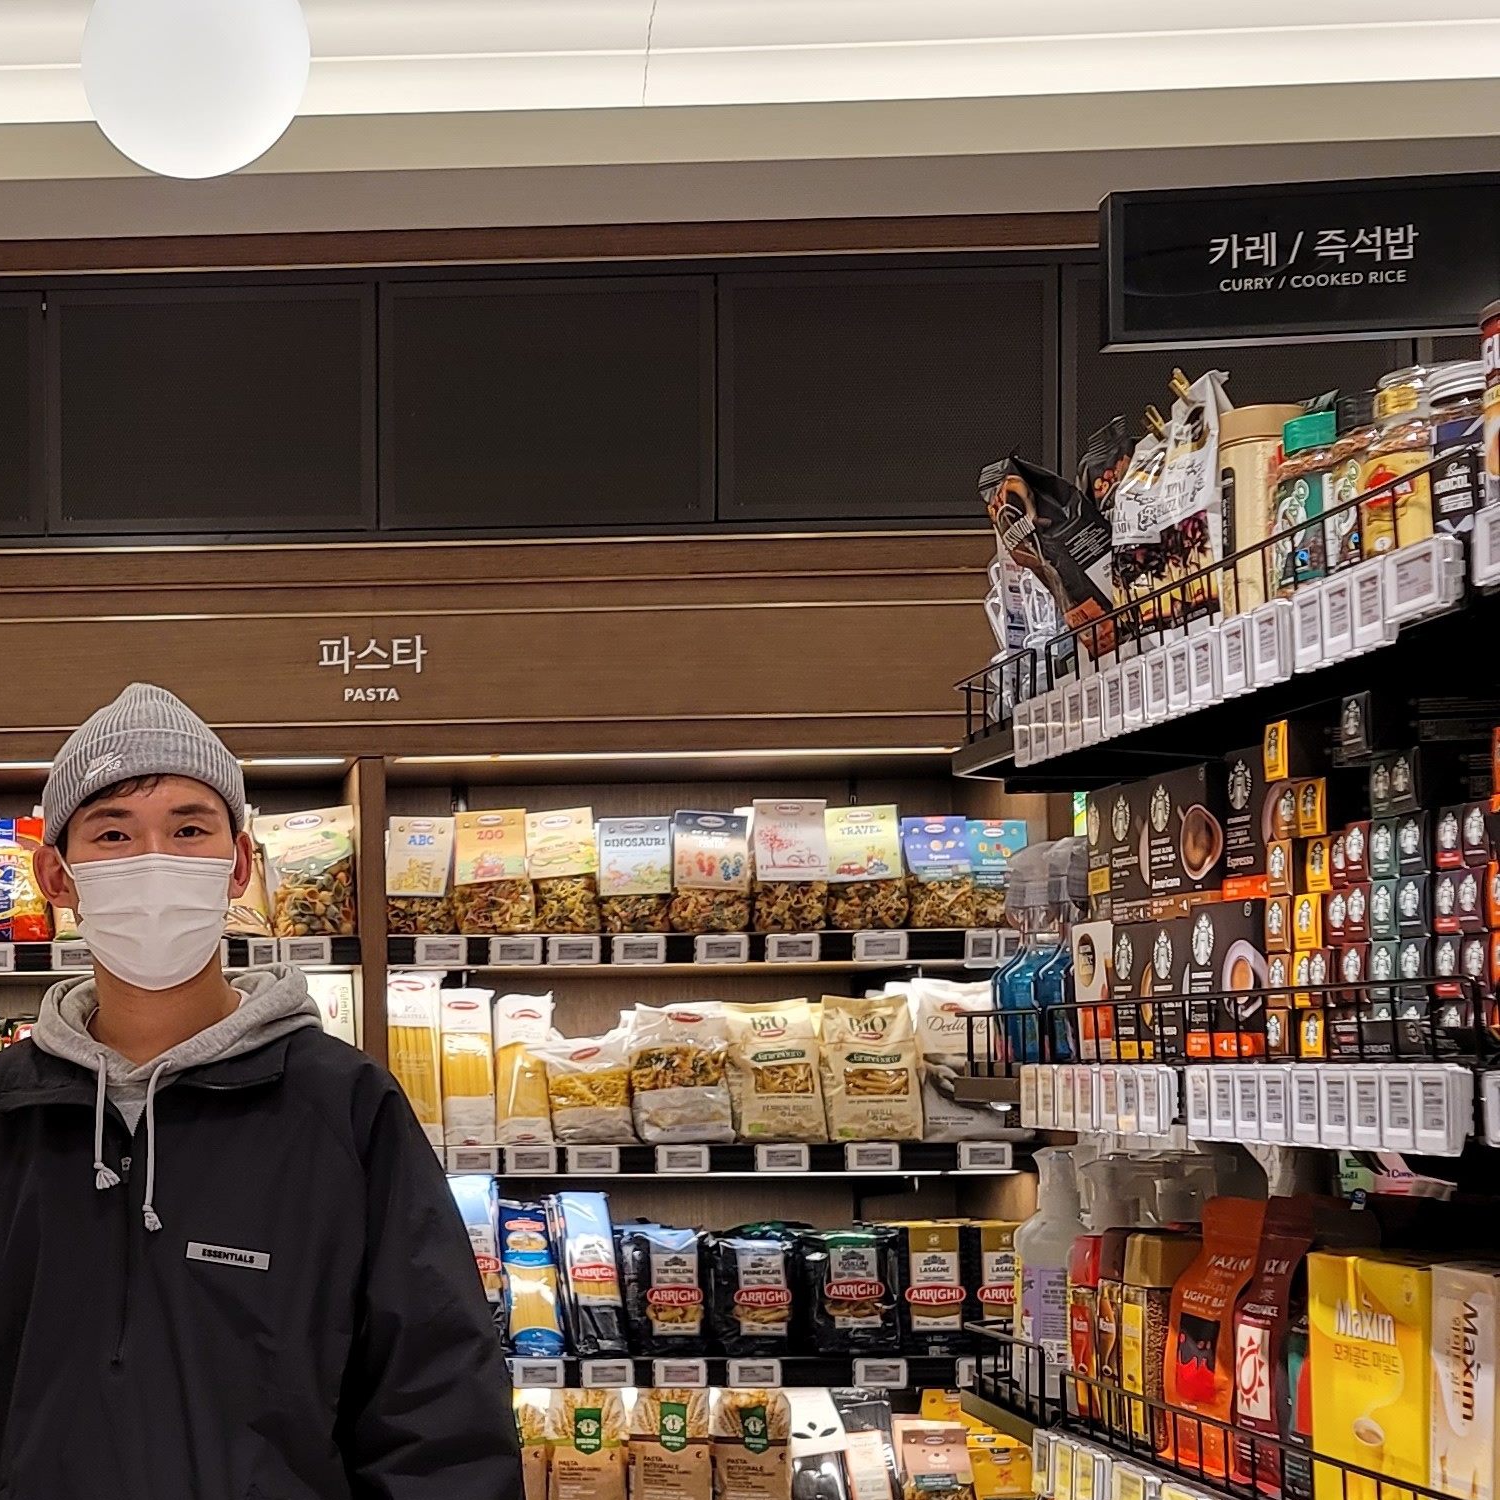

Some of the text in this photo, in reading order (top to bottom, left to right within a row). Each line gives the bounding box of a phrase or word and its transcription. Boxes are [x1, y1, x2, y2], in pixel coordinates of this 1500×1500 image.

[1209, 231, 1277, 269] 카레
[1314, 224, 1419, 264] 즉석밥
[1219, 277, 1274, 292] CURRY
[1290, 272, 1364, 288] COOKED
[1368, 269, 1408, 284] RICE
[319, 635, 428, 674] 파스타
[344, 688, 400, 701] PASTA
[476, 829, 504, 841] ZOO
[839, 825, 882, 836] TRAVEL
[408, 835, 435, 846] ABC
[604, 836, 666, 848] DINOSAURI
[202, 1248, 255, 1264] ESSENTIALS
[919, 1266, 950, 1274] LASAGNE
[652, 1291, 699, 1306] ARRIGHI
[738, 1291, 788, 1305] ARRIGHI
[830, 1283, 879, 1300] ARRIGHI
[911, 1288, 961, 1303] ARRIGHI
[1183, 1289, 1211, 1306] LIGHT
[1335, 1295, 1397, 1346] Maxim
[1462, 1301, 1482, 1422] Maxim
